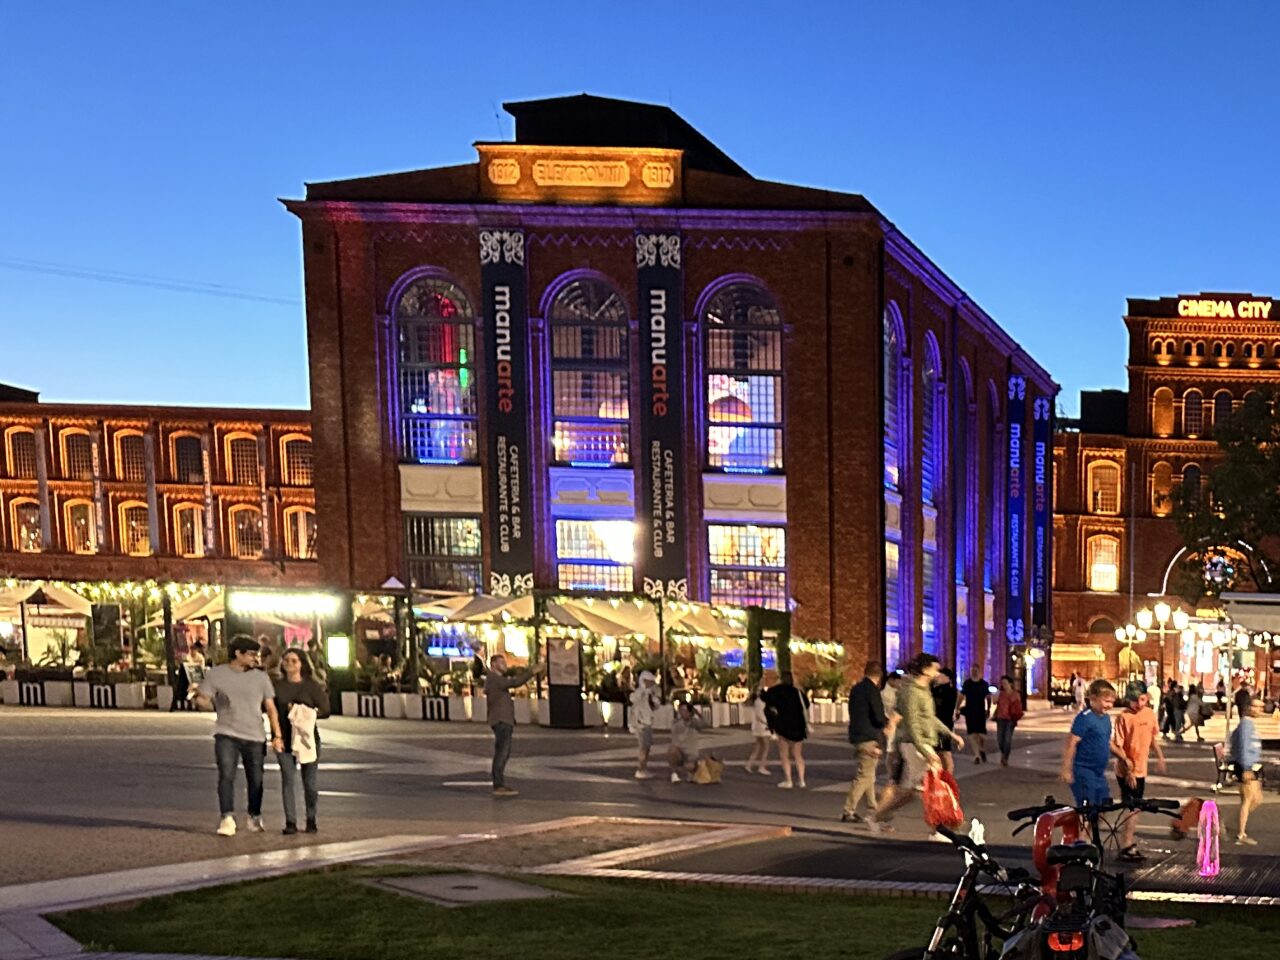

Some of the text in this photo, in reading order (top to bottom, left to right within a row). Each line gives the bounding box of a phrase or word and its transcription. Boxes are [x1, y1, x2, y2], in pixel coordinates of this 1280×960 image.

[647, 165, 671, 183] 1912
[1178, 299, 1272, 319] CINEMA CITY
[494, 285, 515, 414] manuarte
[649, 289, 670, 416] manuarte
[498, 435, 509, 512] RESTAURANTE
[509, 444, 520, 503] CAFETERIA
[651, 440, 663, 517] RESTAURANTE
[663, 449, 674, 509] CAFETERIA
[1010, 423, 1020, 498] manuarte
[1036, 442, 1046, 512] manuarte
[500, 525, 510, 553] CLUB
[511, 515, 522, 539] BAR
[653, 530, 664, 558] CLUB
[664, 521, 675, 544] BAR
